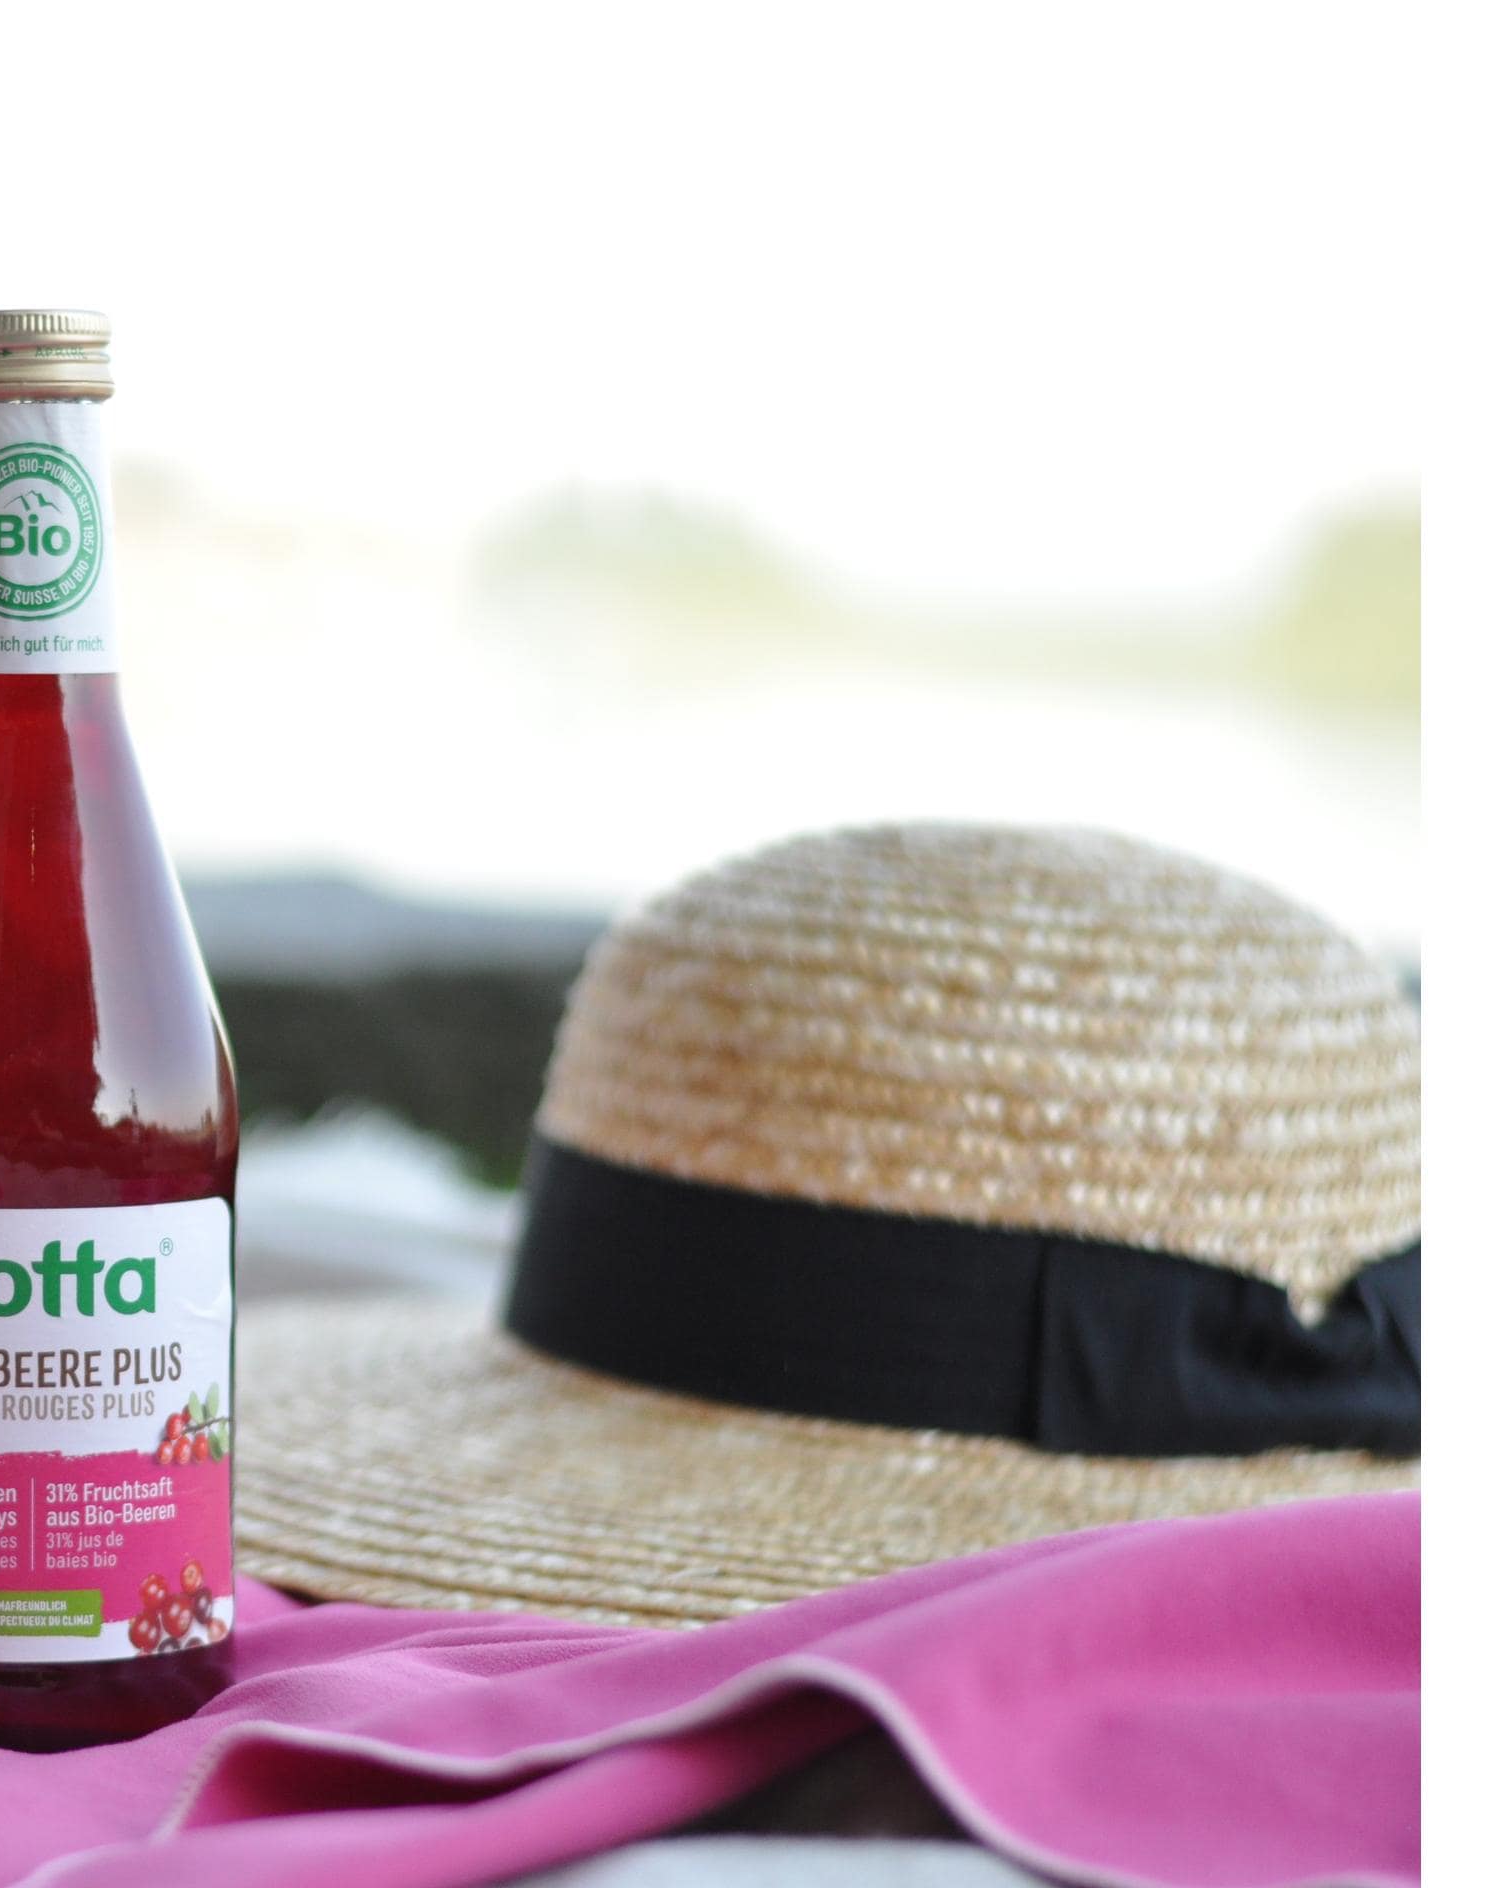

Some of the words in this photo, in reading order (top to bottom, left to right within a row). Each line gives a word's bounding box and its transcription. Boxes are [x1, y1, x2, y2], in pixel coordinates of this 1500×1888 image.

[18, 458, 82, 497] BIO-PIONIER
[77, 494, 93, 522] SEIT
[83, 526, 94, 555] 1957
[13, 586, 60, 605] SUISSE
[59, 576, 76, 596] DU
[75, 560, 90, 581] BIO
[24, 635, 49, 656] gut
[53, 635, 74, 652] für
[113, 1341, 182, 1386] PLUS
[2, 1394, 94, 1420] ROUGES
[103, 1391, 155, 1419] PLUS
[46, 1483, 78, 1503] 31%
[83, 1476, 173, 1502] Fruchtsaft
[46, 1510, 80, 1527] aus
[85, 1503, 175, 1526] Bio-Beeren
[46, 1532, 74, 1549] 31%
[77, 1532, 101, 1552] jus
[106, 1531, 124, 1547] de
[46, 1552, 89, 1569] baies
[93, 1551, 117, 1568] bio
[49, 1615, 61, 1626] DU
[62, 1614, 94, 1625] CLIMAT
